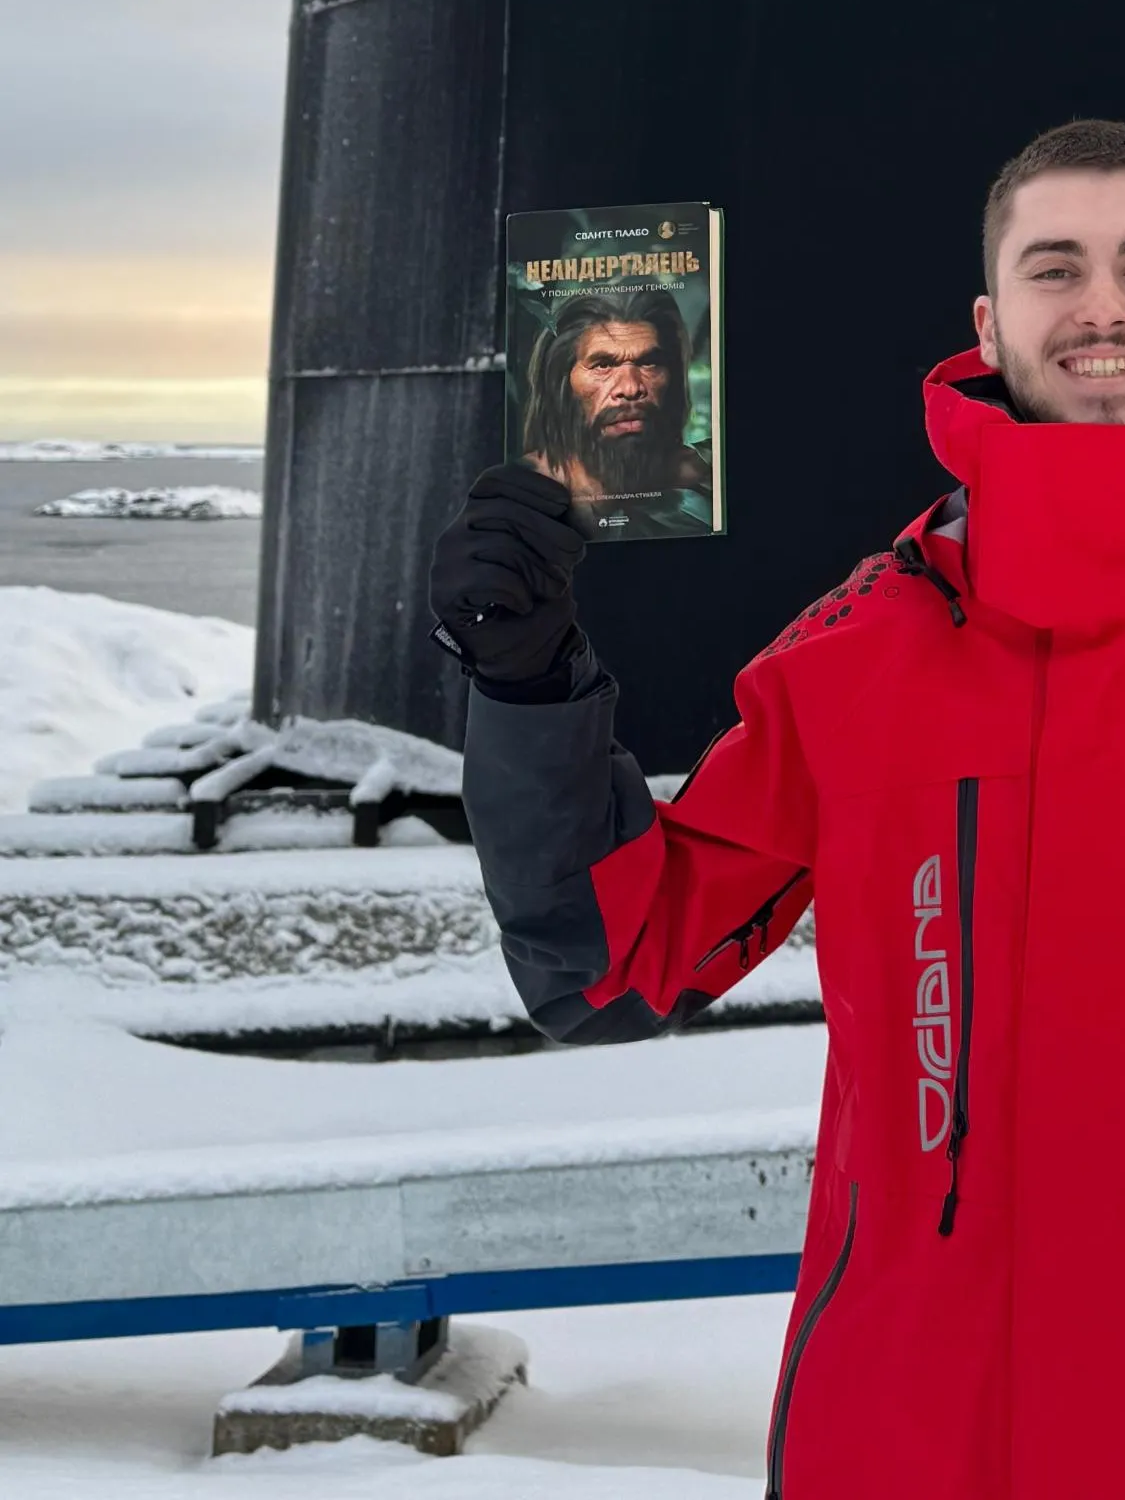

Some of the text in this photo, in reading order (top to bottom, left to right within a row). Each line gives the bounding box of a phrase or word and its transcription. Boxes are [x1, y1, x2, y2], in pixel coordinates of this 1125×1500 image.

[575, 230, 613, 241] СВАНТЕ
[526, 251, 700, 283] НЕАНДЕРТАЛЕЦЬ
[541, 281, 685, 298] У ПОШУКАХ УТРАЧЕНИХ ГЕНОМІВ
